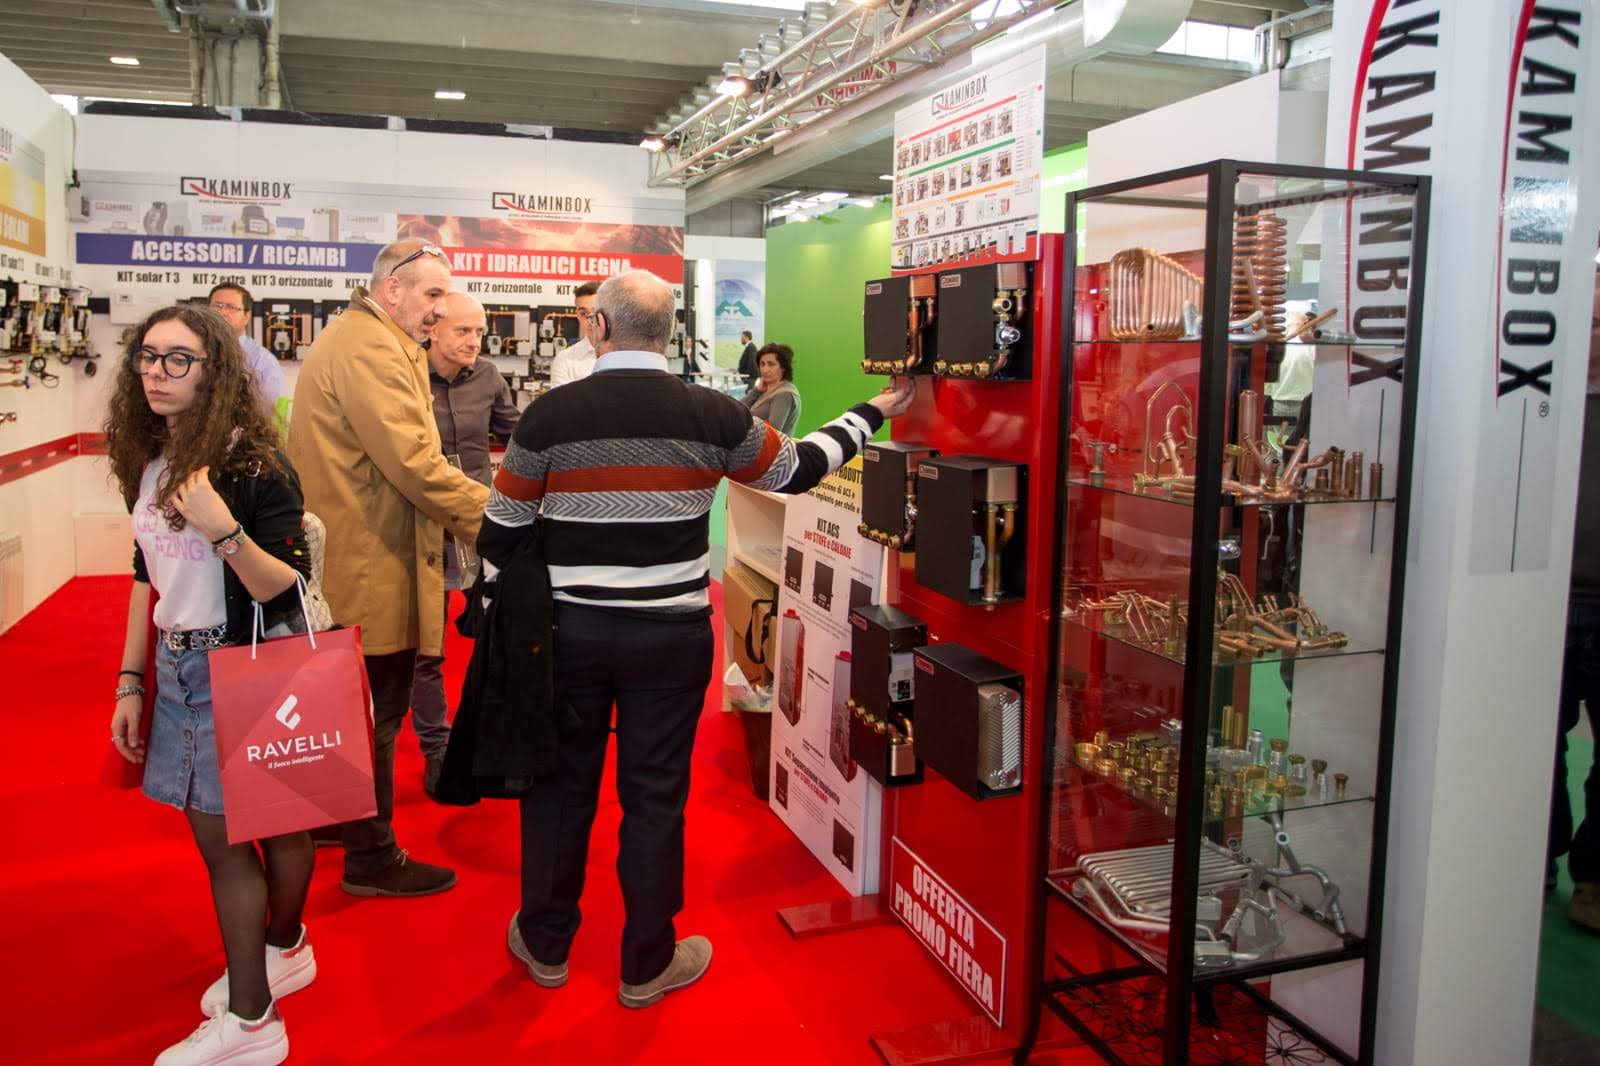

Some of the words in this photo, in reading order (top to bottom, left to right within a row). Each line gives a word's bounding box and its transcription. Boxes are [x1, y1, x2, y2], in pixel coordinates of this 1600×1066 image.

[945, 74, 988, 106] KAMINBOX
[208, 179, 292, 199] KAMINBOX
[1350, 10, 1440, 387] KAMNBOX
[517, 194, 592, 213] KAMINBOX
[131, 240, 243, 263] ACCESSORI
[248, 244, 258, 265] /
[263, 245, 346, 267] RICAMBI
[453, 252, 483, 272] KIT
[487, 253, 576, 275] IDRAULICI
[580, 256, 631, 276] LEGNA
[117, 270, 133, 282] KIT
[136, 271, 163, 284] solar
[173, 272, 180, 283] 3
[193, 273, 208, 284] KIT
[211, 274, 217, 285] 2
[252, 275, 268, 286] KIT
[270, 276, 276, 287] 3
[278, 275, 333, 288] orizzontale
[467, 281, 482, 293] KIT
[484, 282, 490, 293] 2
[491, 282, 543, 294] orizzontale
[556, 285, 570, 295] KIT
[827, 522, 840, 539] ACS
[247, 730, 341, 762] RAVELLI
[913, 864, 975, 950] OFFERTA
[895, 882, 946, 957] PROMO
[949, 937, 994, 1012] FIERA
